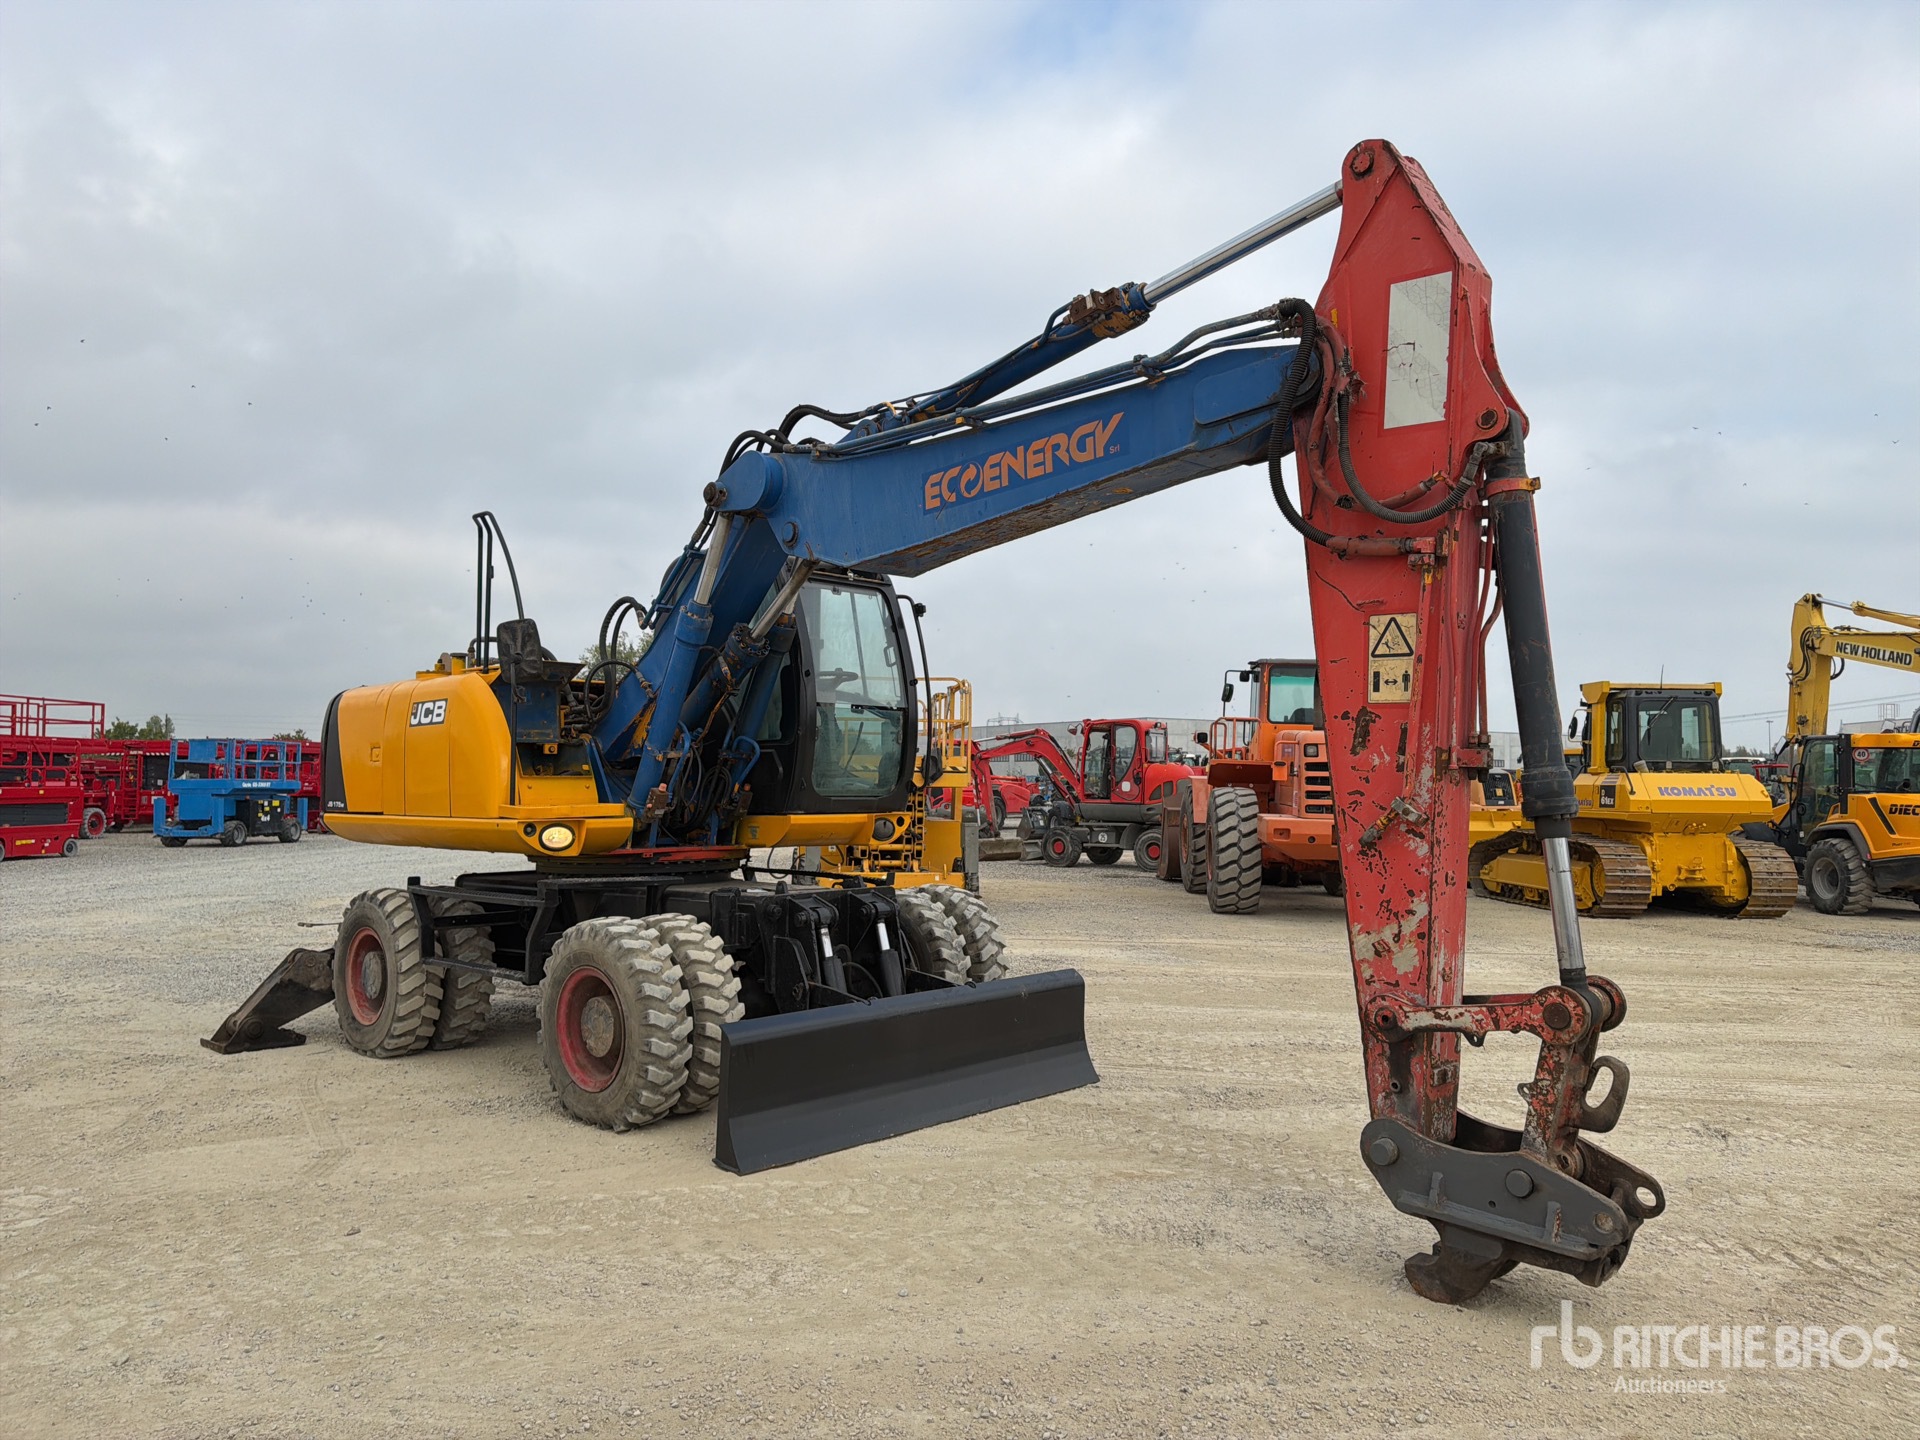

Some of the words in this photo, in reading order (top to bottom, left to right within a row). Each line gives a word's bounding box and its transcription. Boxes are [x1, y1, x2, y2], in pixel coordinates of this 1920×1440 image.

[924, 411, 1125, 510] ECOENERGY
[1835, 641, 1860, 656] NEW
[1861, 645, 1913, 666] HOLLAND
[410, 700, 447, 726] JCB
[1857, 750, 1866, 758] 40
[1657, 784, 1737, 798] KOMATSU
[1601, 797, 1614, 805] 61EX
